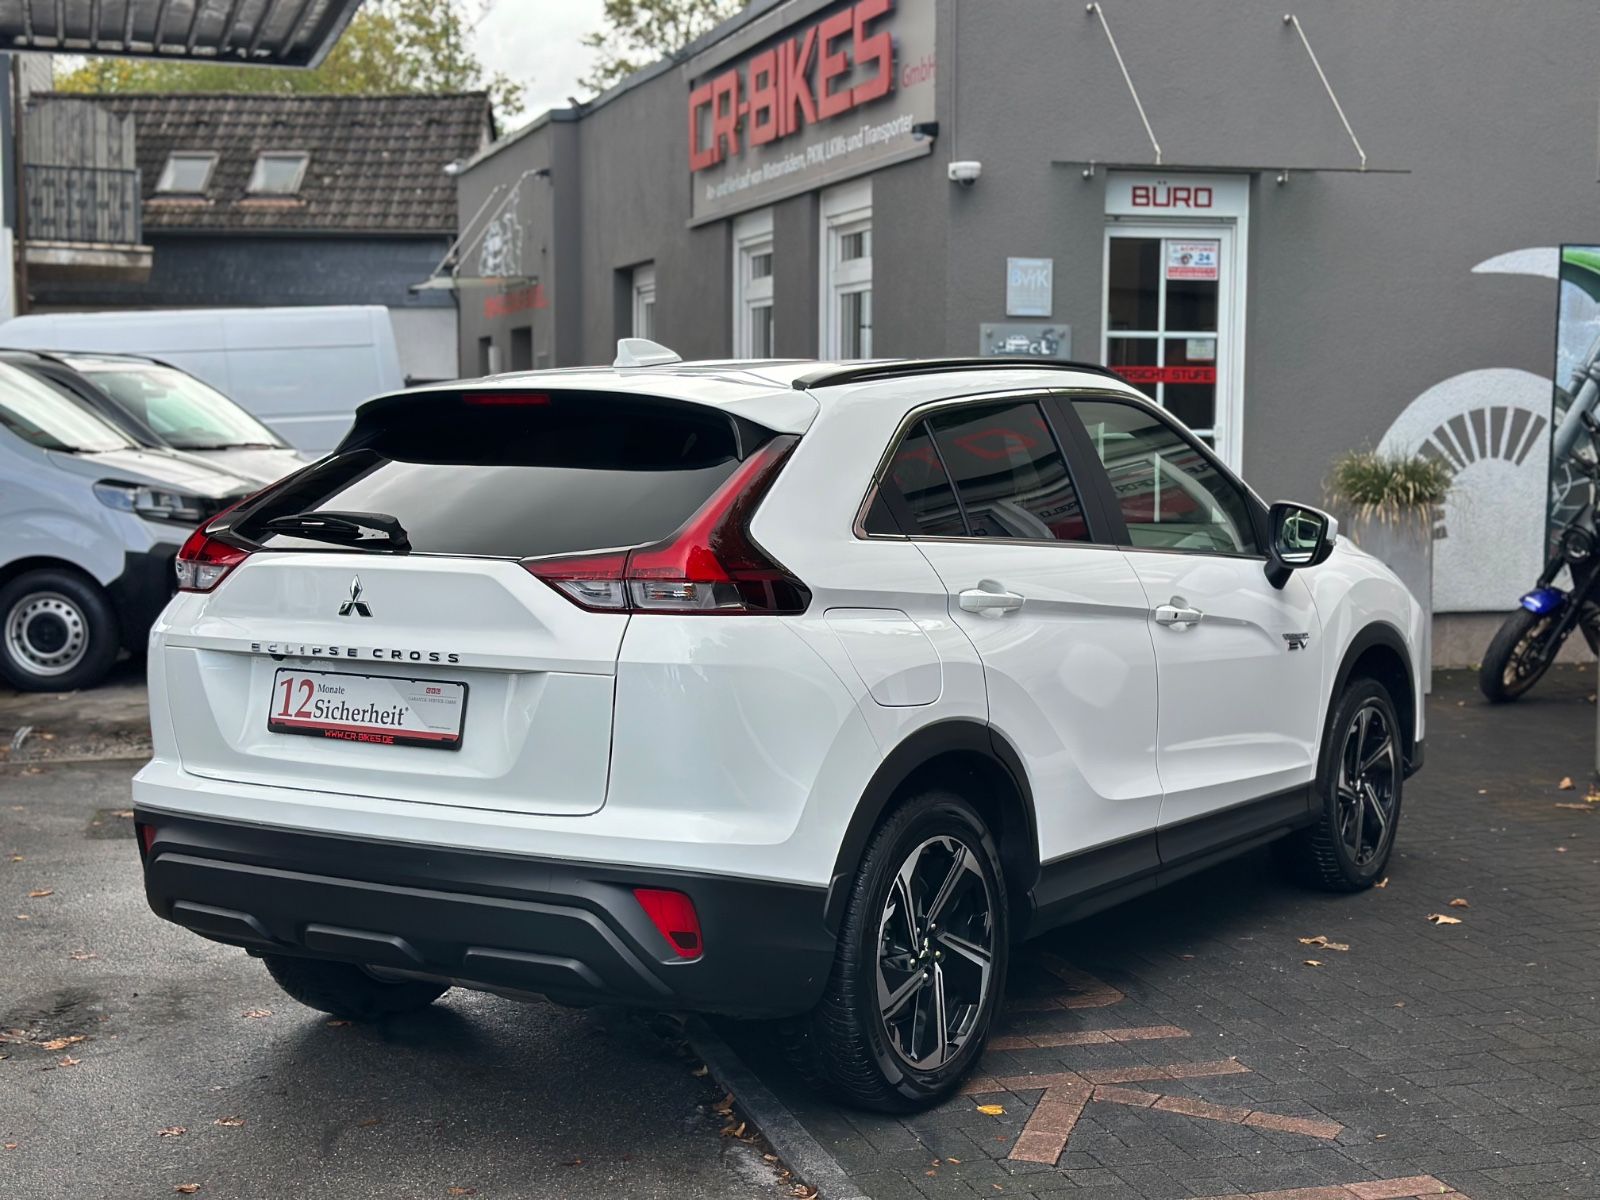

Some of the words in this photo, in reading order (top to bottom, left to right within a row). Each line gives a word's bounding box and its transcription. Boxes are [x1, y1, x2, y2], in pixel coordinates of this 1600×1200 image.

[689, 0, 896, 172] CR-BIKES
[847, 126, 863, 152] und
[863, 113, 913, 146] Transporter
[1132, 180, 1212, 208] BÜRO
[1172, 369, 1212, 380] STUFE
[251, 643, 359, 658] ECLIPSE
[372, 648, 460, 663] CROSS
[277, 677, 315, 719] 12
[317, 683, 346, 695] Monate
